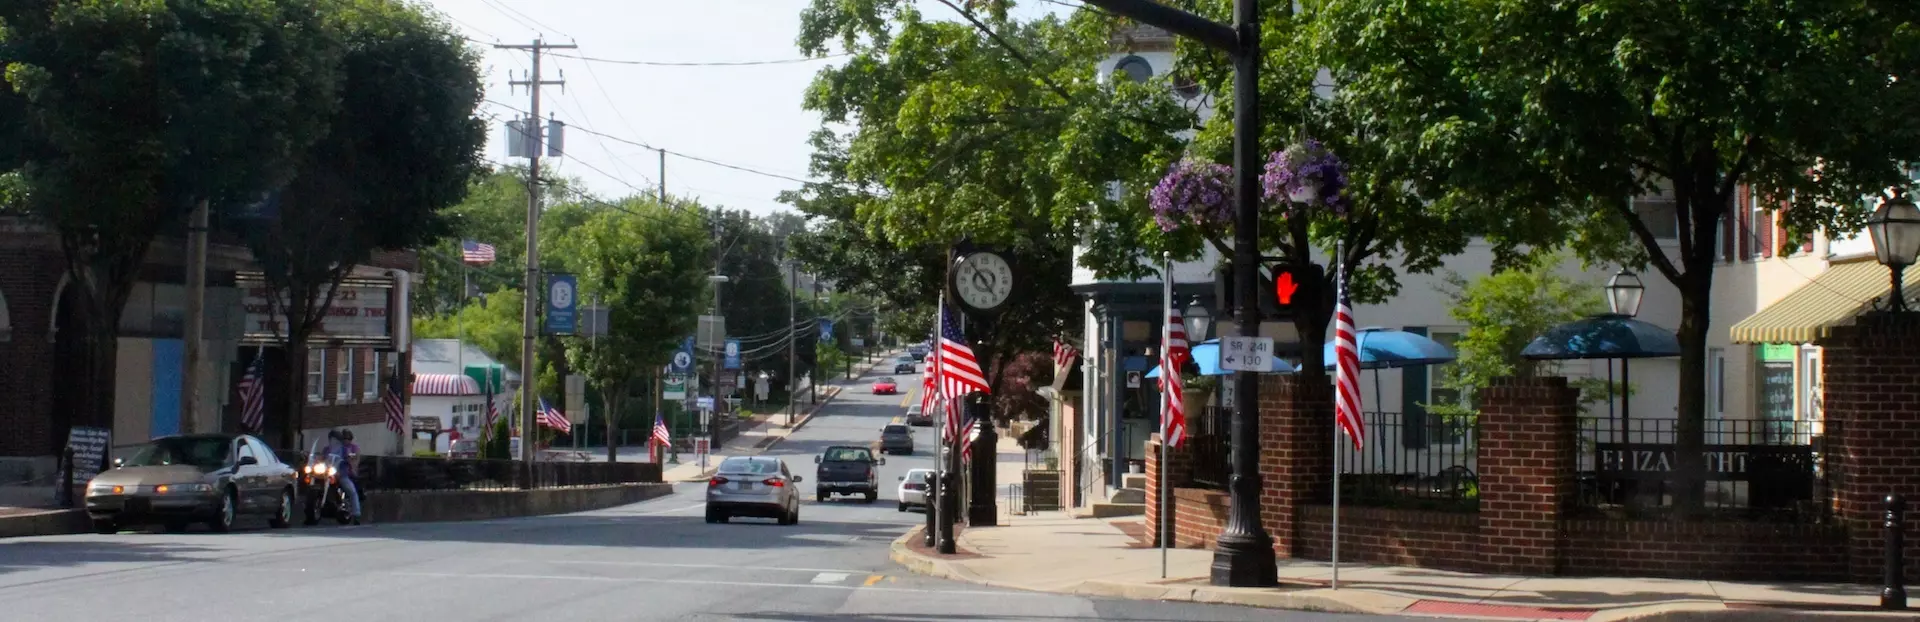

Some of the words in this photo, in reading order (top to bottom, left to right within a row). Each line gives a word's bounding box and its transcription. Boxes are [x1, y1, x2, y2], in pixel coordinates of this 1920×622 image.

[1231, 341, 1243, 350] SR
[1250, 342, 1267, 352] 241
[1243, 356, 1262, 365] 130
